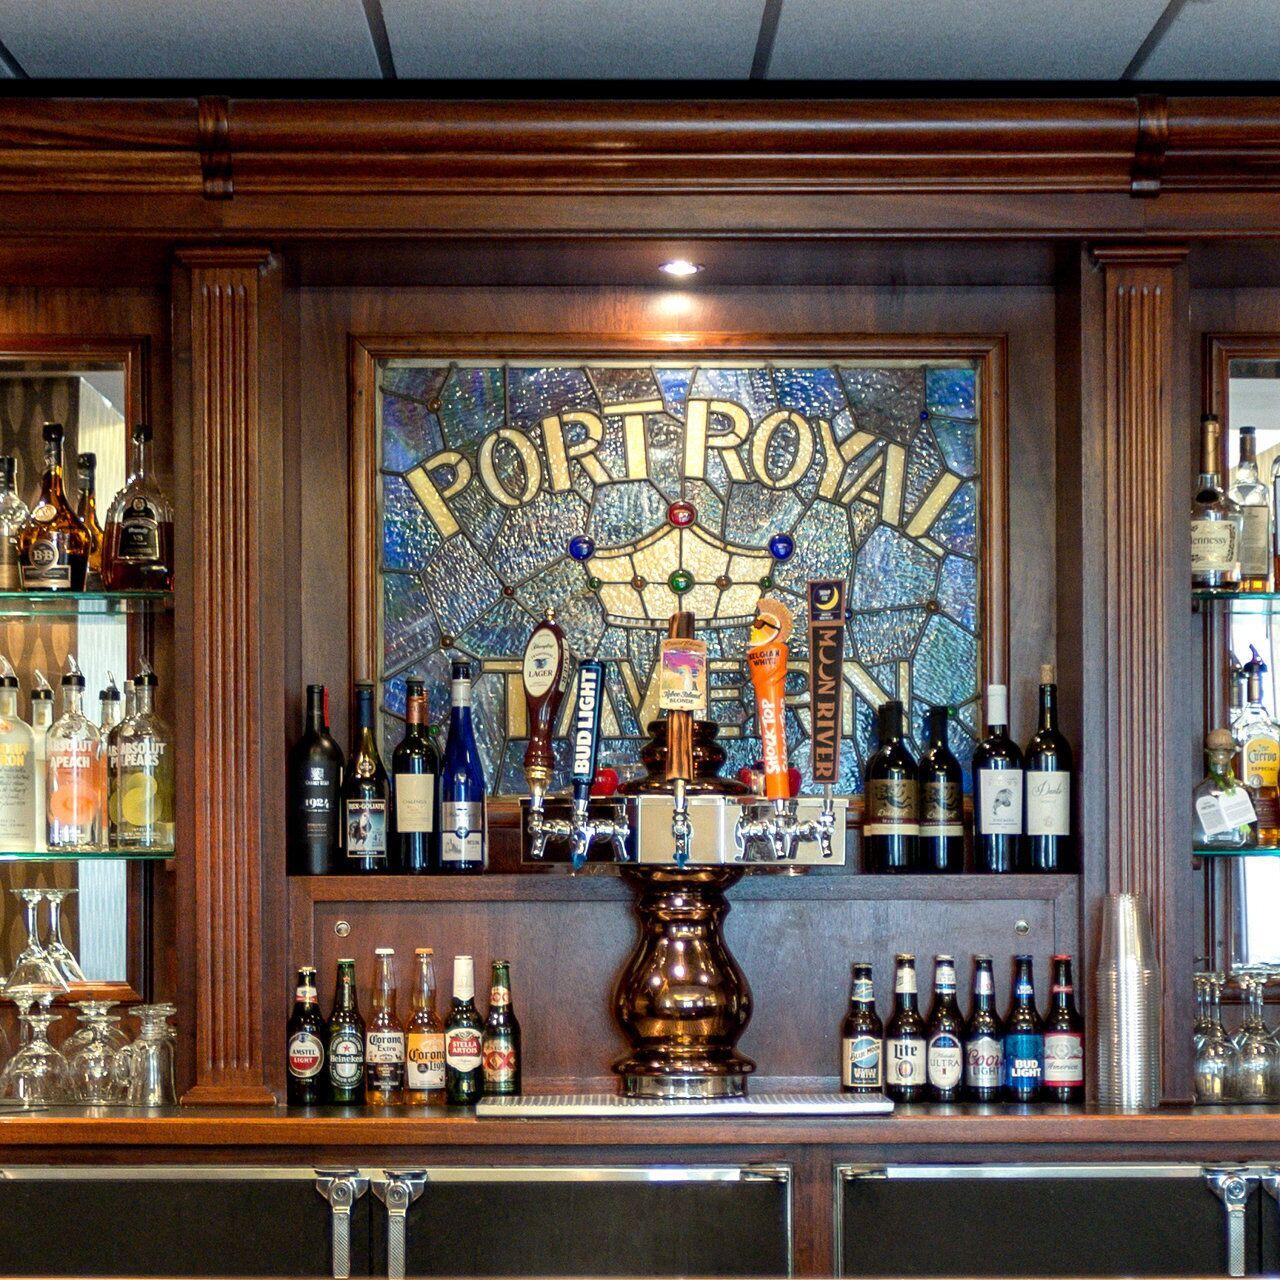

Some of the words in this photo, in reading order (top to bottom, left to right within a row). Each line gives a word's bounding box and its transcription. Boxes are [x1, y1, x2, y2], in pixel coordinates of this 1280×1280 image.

[404, 398, 664, 540] PORT
[683, 397, 964, 558] ROYAL
[818, 629, 838, 694] MOON
[528, 670, 554, 679] LAGER
[578, 669, 598, 729] LIGHT
[761, 697, 777, 728] TOP
[815, 701, 836, 781] RIVER
[574, 730, 593, 774] BUD
[764, 729, 781, 775] SHOCK
[50, 756, 91, 769] APEACH
[124, 754, 160, 767] PEARS
[305, 797, 330, 810] 1924
[369, 1033, 402, 1045] Corona
[452, 1040, 478, 1048] STELLA
[293, 1048, 316, 1056] AMSTEL
[329, 1054, 364, 1063] Heineken
[407, 1048, 447, 1063] Corona
[894, 1044, 918, 1060] Lite
[429, 1061, 447, 1072] Ligh
[929, 1059, 961, 1067] ULTRA
[1015, 1059, 1039, 1069] BUD
[1011, 1068, 1042, 1078] LIGHT
